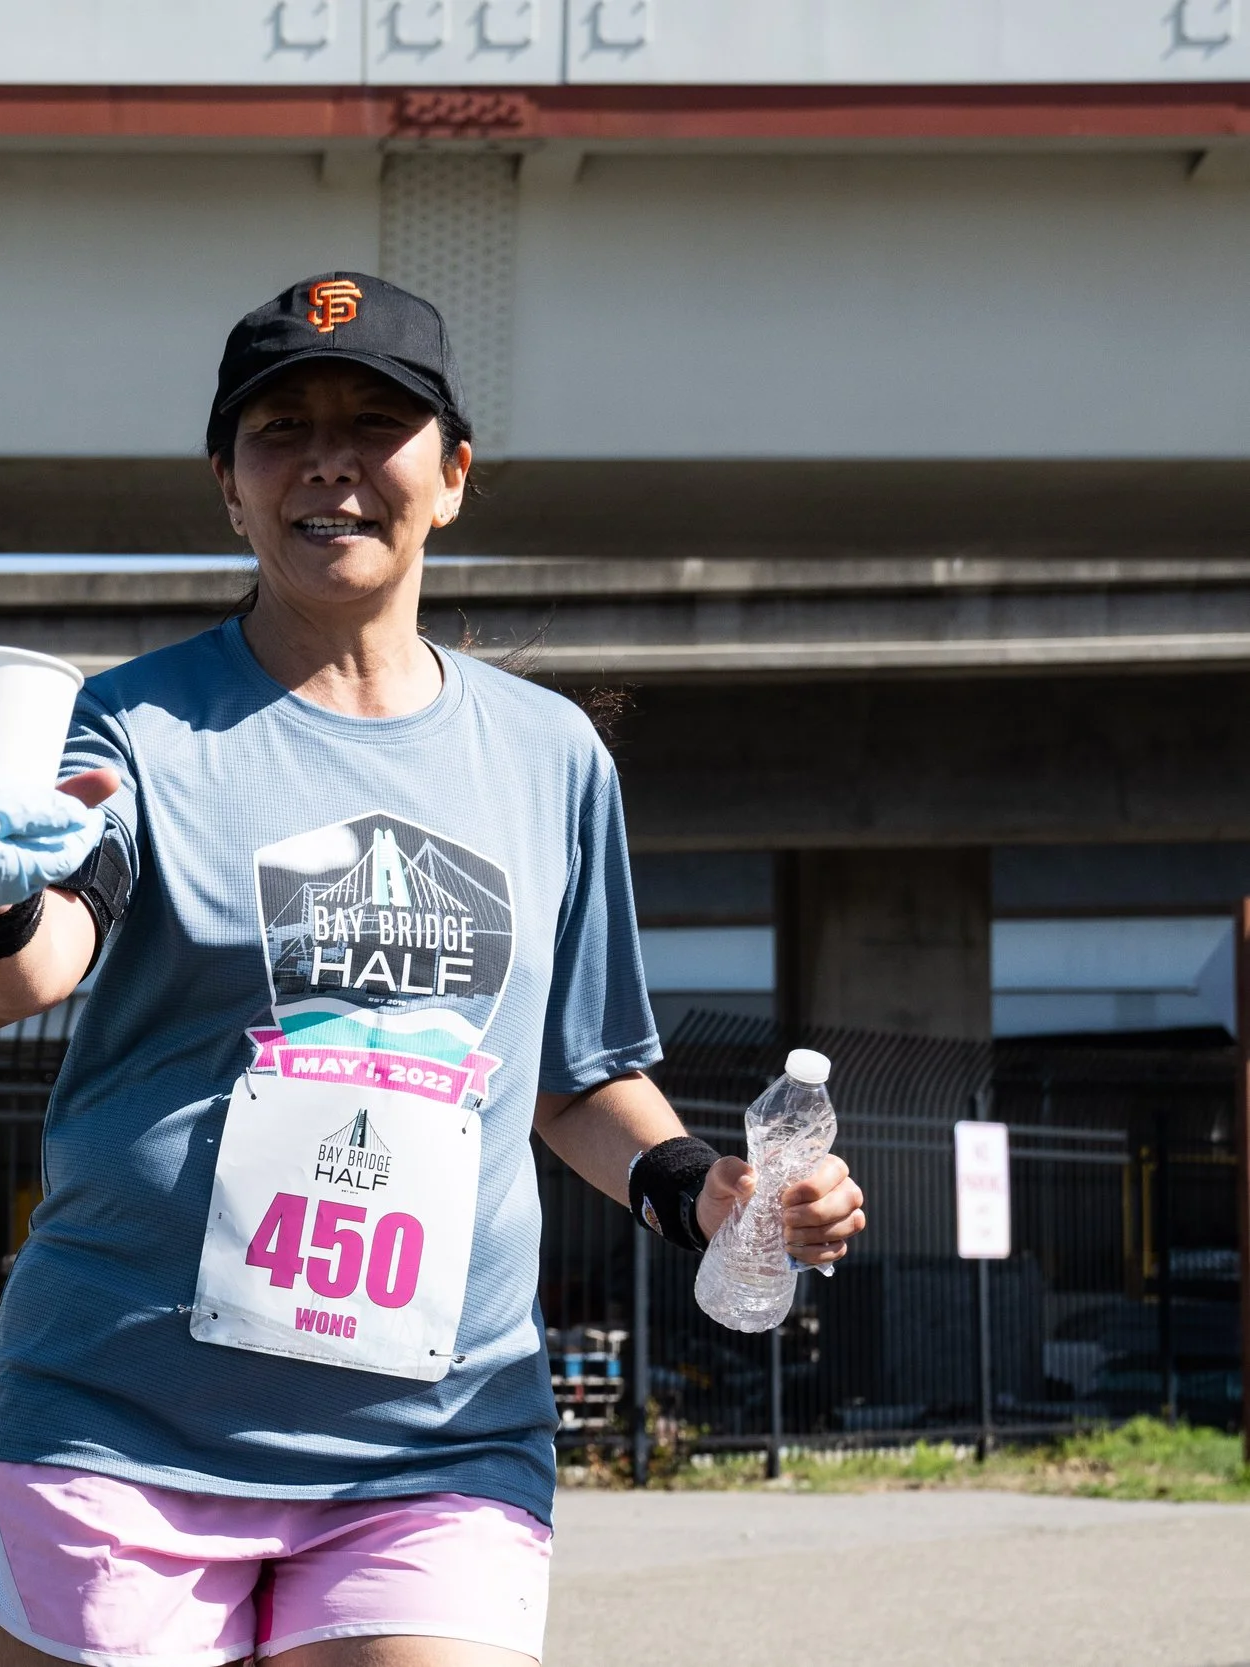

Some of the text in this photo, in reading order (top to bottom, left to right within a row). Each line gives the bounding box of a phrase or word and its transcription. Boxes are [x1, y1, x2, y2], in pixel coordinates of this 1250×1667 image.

[313, 905, 474, 953] BAY BRIDGE
[310, 946, 474, 996] HALF
[292, 1057, 453, 1094] MAY 1, 2022
[314, 1163, 389, 1191] HALF
[318, 1144, 392, 1173] BAY BRIDGE
[245, 1191, 425, 1309] 450
[294, 1307, 358, 1339] WONG
